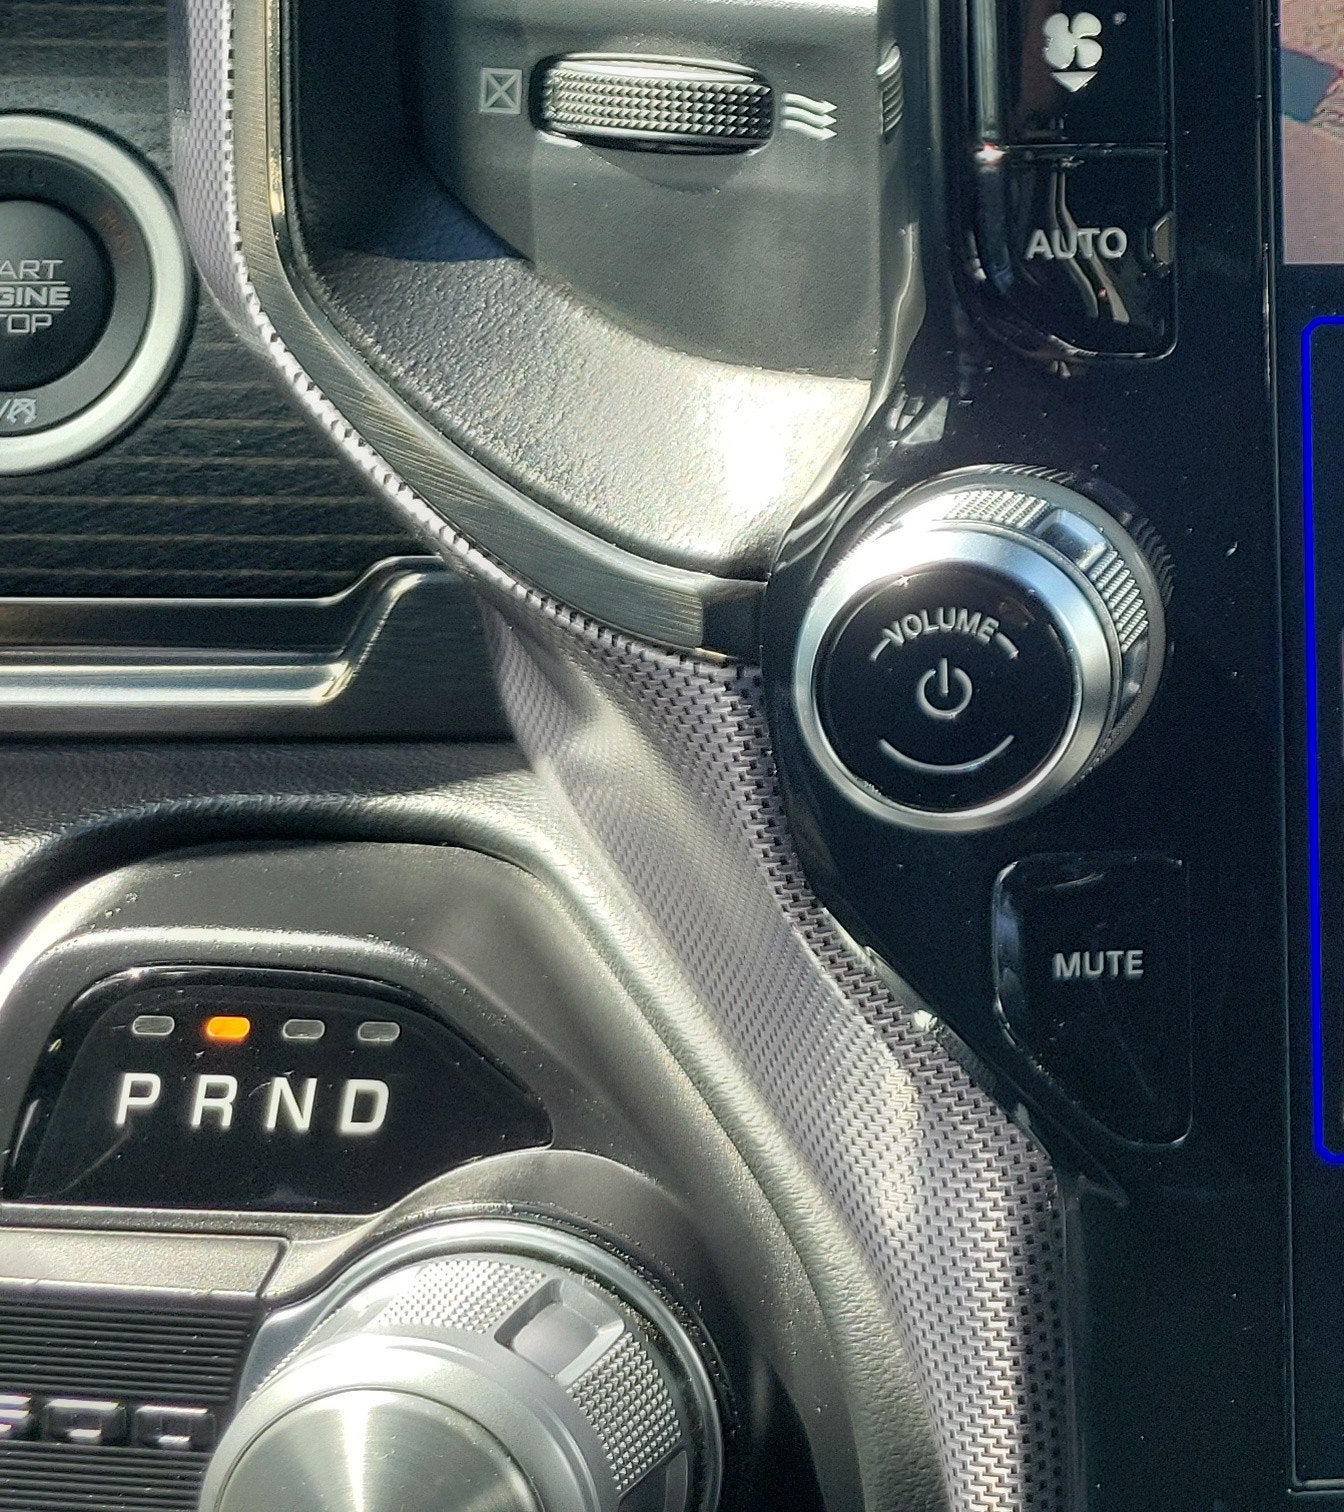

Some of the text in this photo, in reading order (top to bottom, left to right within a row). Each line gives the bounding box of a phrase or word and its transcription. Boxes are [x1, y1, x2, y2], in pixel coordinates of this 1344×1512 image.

[1025, 226, 1128, 261] AUTO
[884, 607, 1000, 647] VOLUME
[1051, 948, 1145, 981] MUTE
